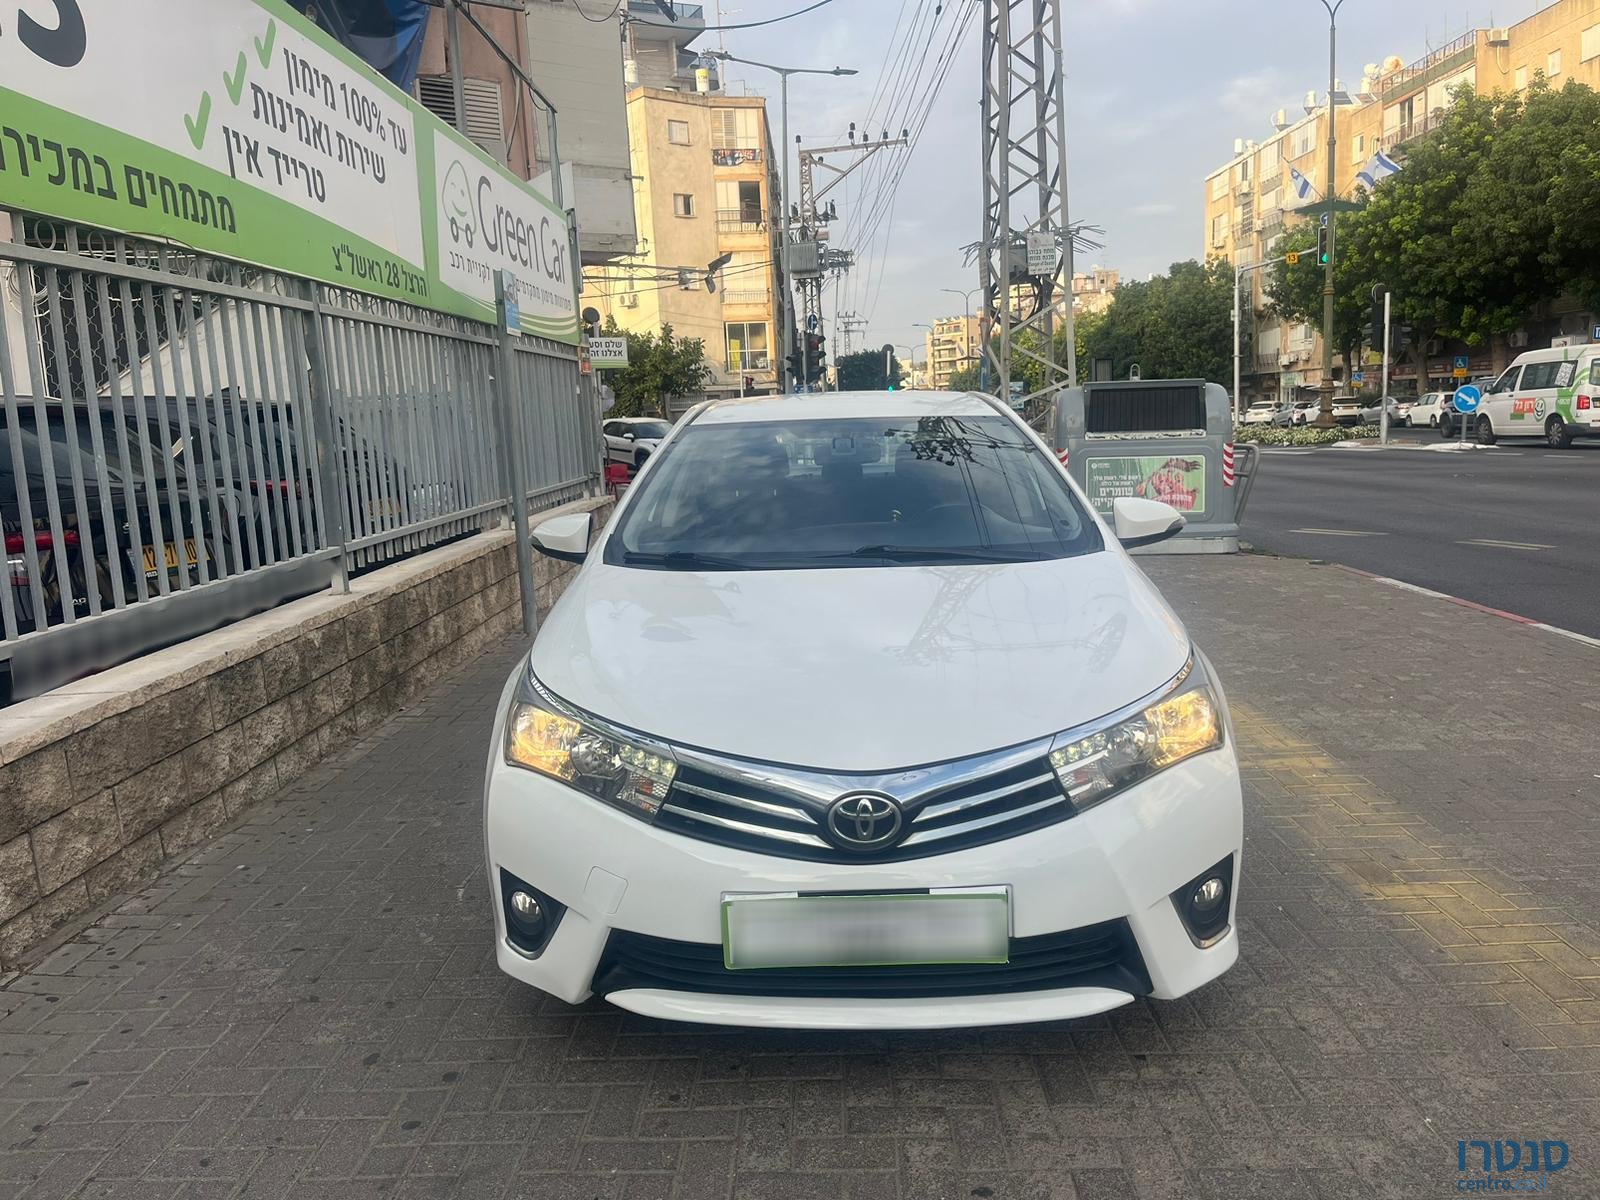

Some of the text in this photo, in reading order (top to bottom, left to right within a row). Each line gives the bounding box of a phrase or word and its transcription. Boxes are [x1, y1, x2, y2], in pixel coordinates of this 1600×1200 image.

[283, 48, 407, 155] עד 100% מימון
[250, 82, 386, 184] שירות ואמינות
[222, 125, 326, 203] טרייד אין
[0, 125, 237, 233] מתמחים במכיר
[478, 175, 566, 285] Green Car
[449, 251, 465, 271] רכב
[467, 258, 490, 284] לקניית
[1287, 254, 1296, 262] 13
[384, 261, 400, 288] 28
[401, 264, 427, 297] הרצל
[601, 349, 623, 357] אצלנו
[604, 340, 622, 348] שלם
[1099, 487, 1134, 497] שומרים
